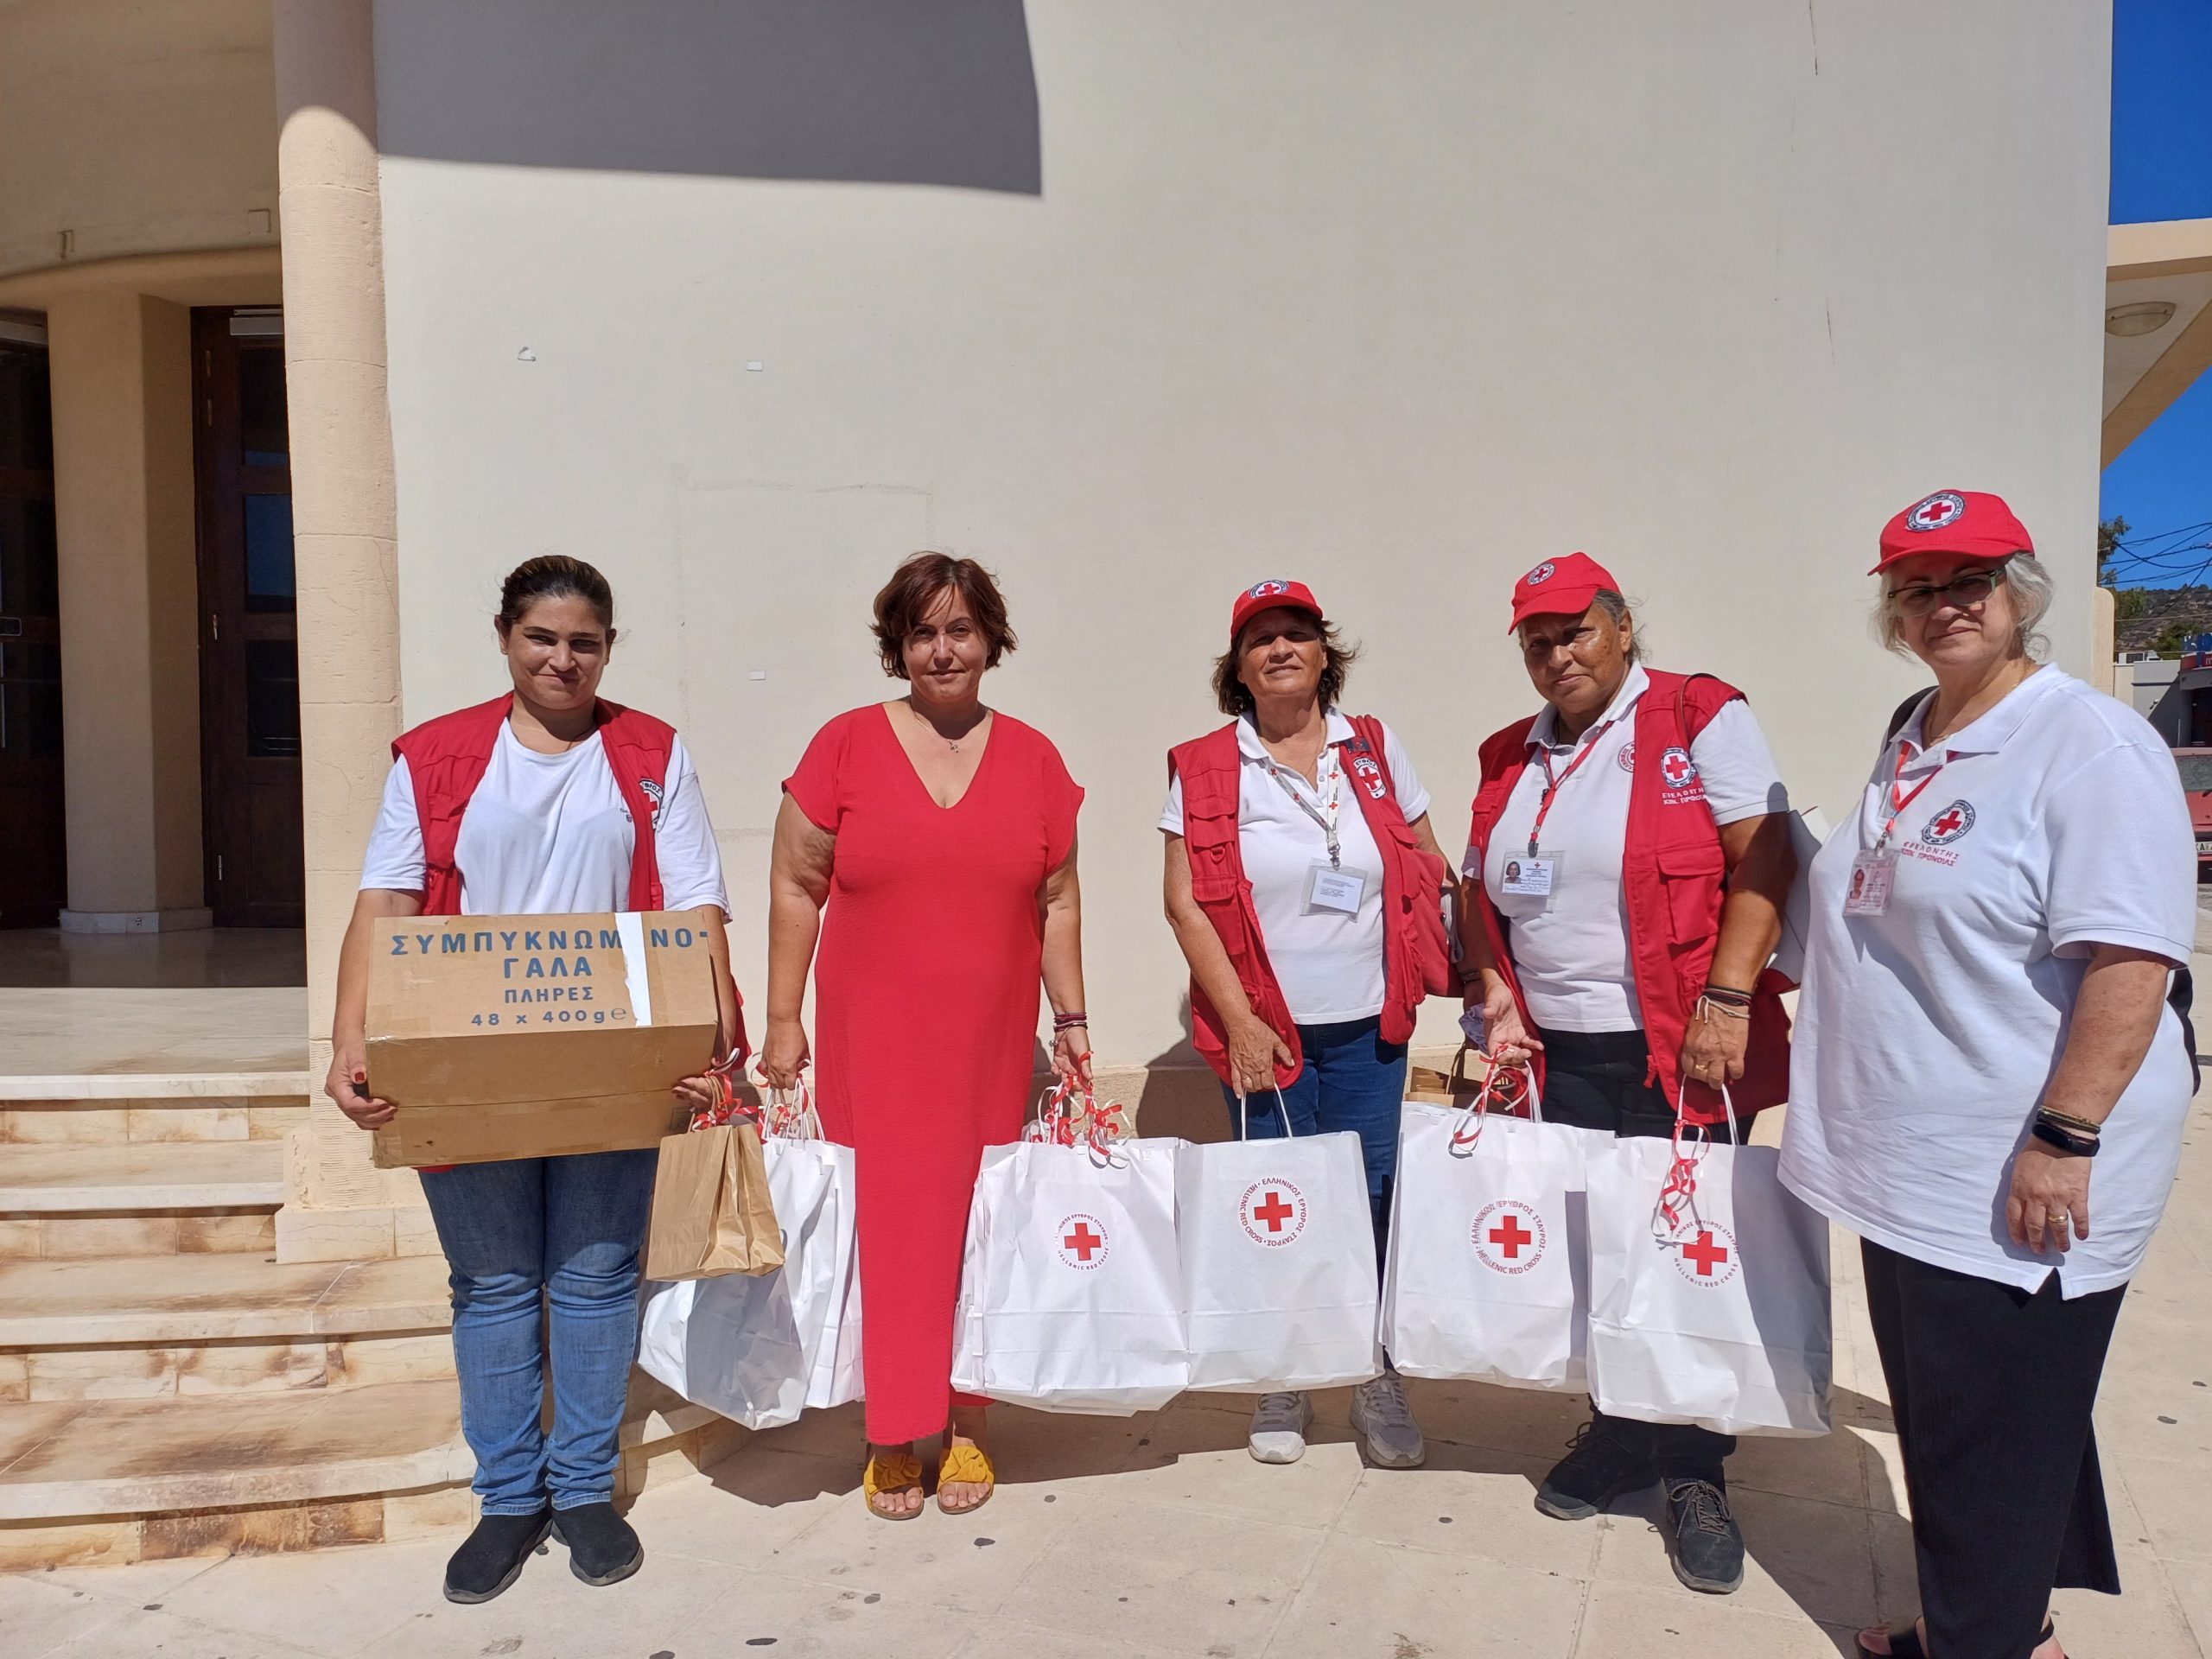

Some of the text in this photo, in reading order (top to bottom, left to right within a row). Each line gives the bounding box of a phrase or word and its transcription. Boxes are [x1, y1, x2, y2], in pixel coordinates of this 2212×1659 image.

[391, 928, 708, 956] ΣΥΜΠΥΚΝΩΜΝΟ-
[505, 957, 592, 978] ΓΑΛΑ
[505, 987, 594, 1004] ΠΛΗΡΕΣ
[472, 1014, 499, 1027] 48
[1240, 1183, 1258, 1211] HELLENIC
[1262, 1178, 1306, 1246] ΕΛΛΗΝΙΚΟΣ ΕΡΥΘΡΟΣ ΣΤΑΥΡΟΣ
[1245, 1226, 1263, 1243] CROSS
[1533, 1215, 1546, 1249] ΣΤΑΥΡΟΣ
[1523, 1253, 1541, 1270] CROSS
